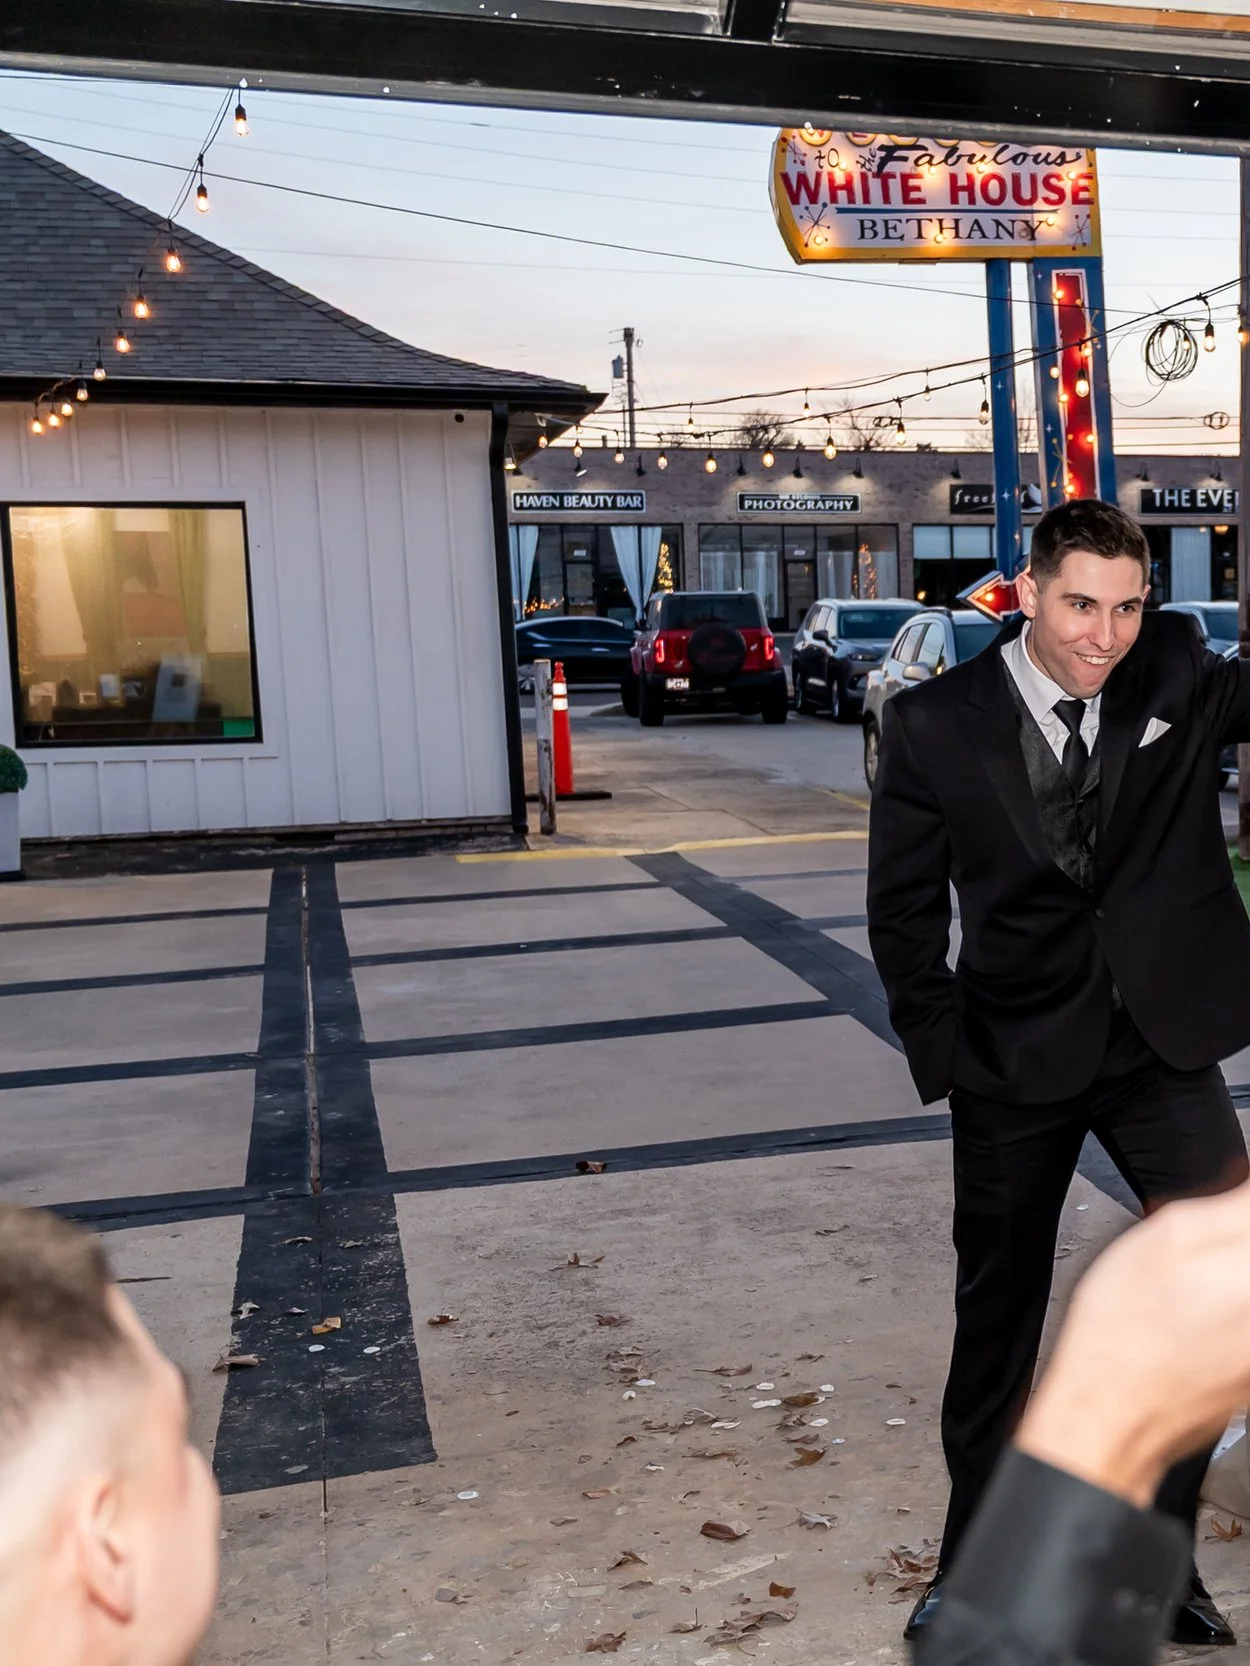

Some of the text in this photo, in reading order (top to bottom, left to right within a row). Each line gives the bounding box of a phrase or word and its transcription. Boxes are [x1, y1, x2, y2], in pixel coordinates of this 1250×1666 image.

[855, 146, 877, 173] the
[875, 143, 1083, 178] Fabulous
[780, 171, 1095, 206] WHITE HOUSE
[857, 218, 1047, 241] BETHANY
[515, 495, 642, 508] HAVEN BEAUTY BAR
[744, 500, 854, 511] PHOTOGRAPHY
[1152, 489, 1191, 508] THE
